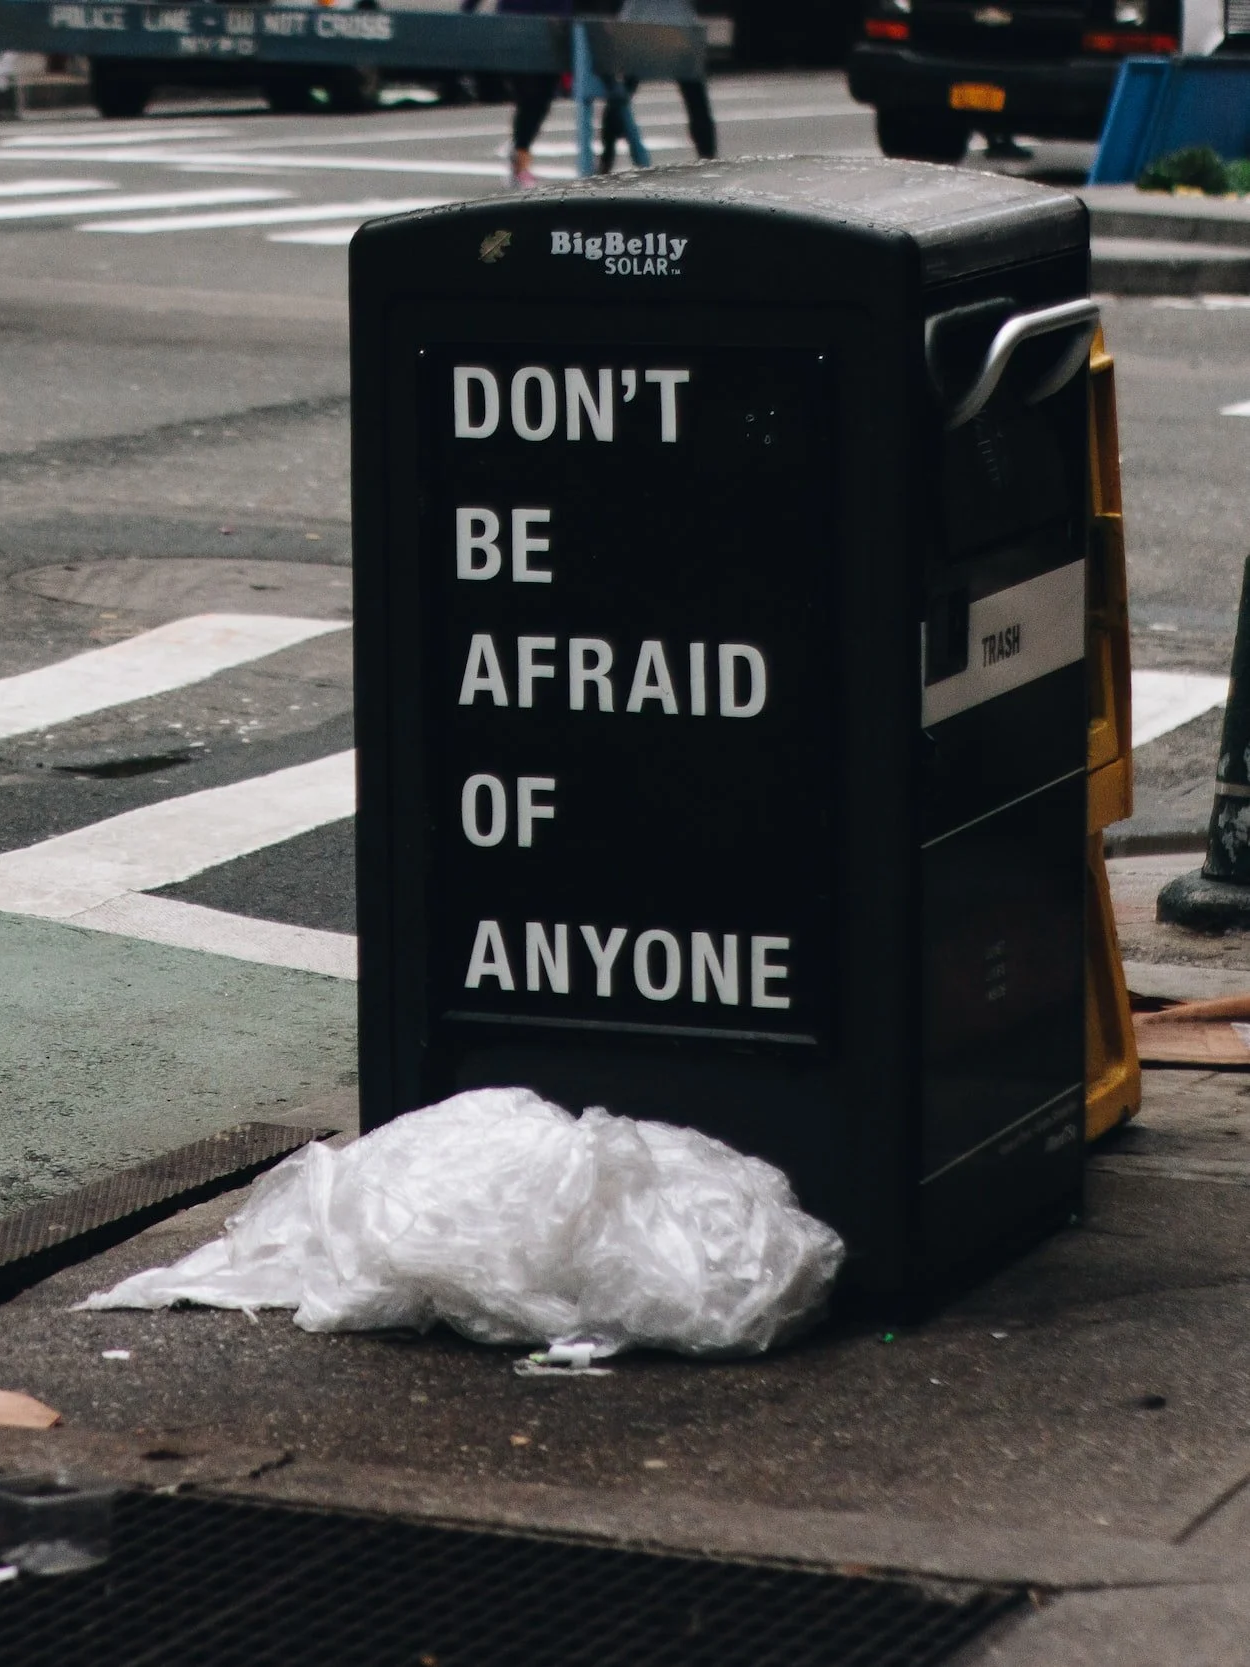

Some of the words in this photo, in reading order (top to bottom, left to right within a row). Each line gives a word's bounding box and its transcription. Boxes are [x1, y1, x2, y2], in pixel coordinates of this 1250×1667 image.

[550, 231, 688, 260] BigBelly
[604, 257, 669, 275] SOLAR
[453, 366, 690, 443] DON'T
[456, 507, 553, 583] BE
[458, 633, 767, 718] AFRAID
[981, 622, 1021, 669] TRASH
[461, 773, 556, 848] OF
[464, 920, 791, 1009] ANYONE
